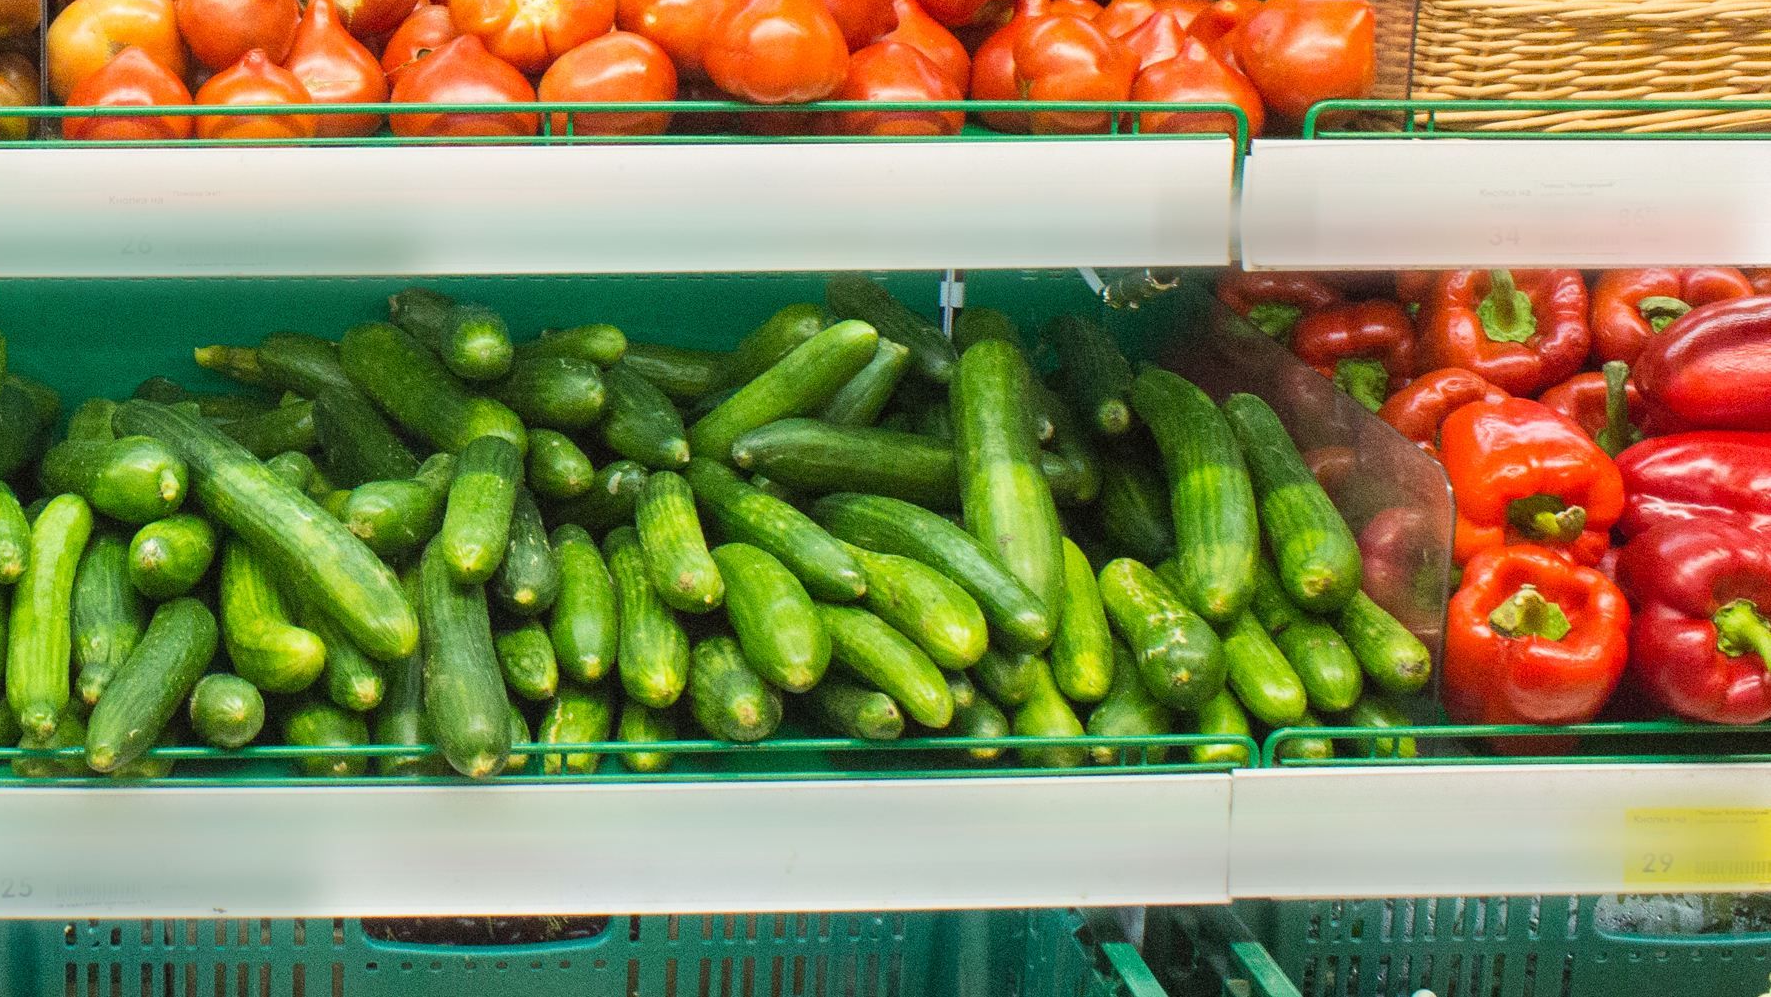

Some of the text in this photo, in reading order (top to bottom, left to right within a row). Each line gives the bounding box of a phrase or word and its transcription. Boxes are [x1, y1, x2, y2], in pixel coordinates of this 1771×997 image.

[121, 234, 153, 255] 26
[1488, 226, 1521, 246] 34
[1641, 852, 1674, 873] 29
[0, 876, 34, 899] 25
